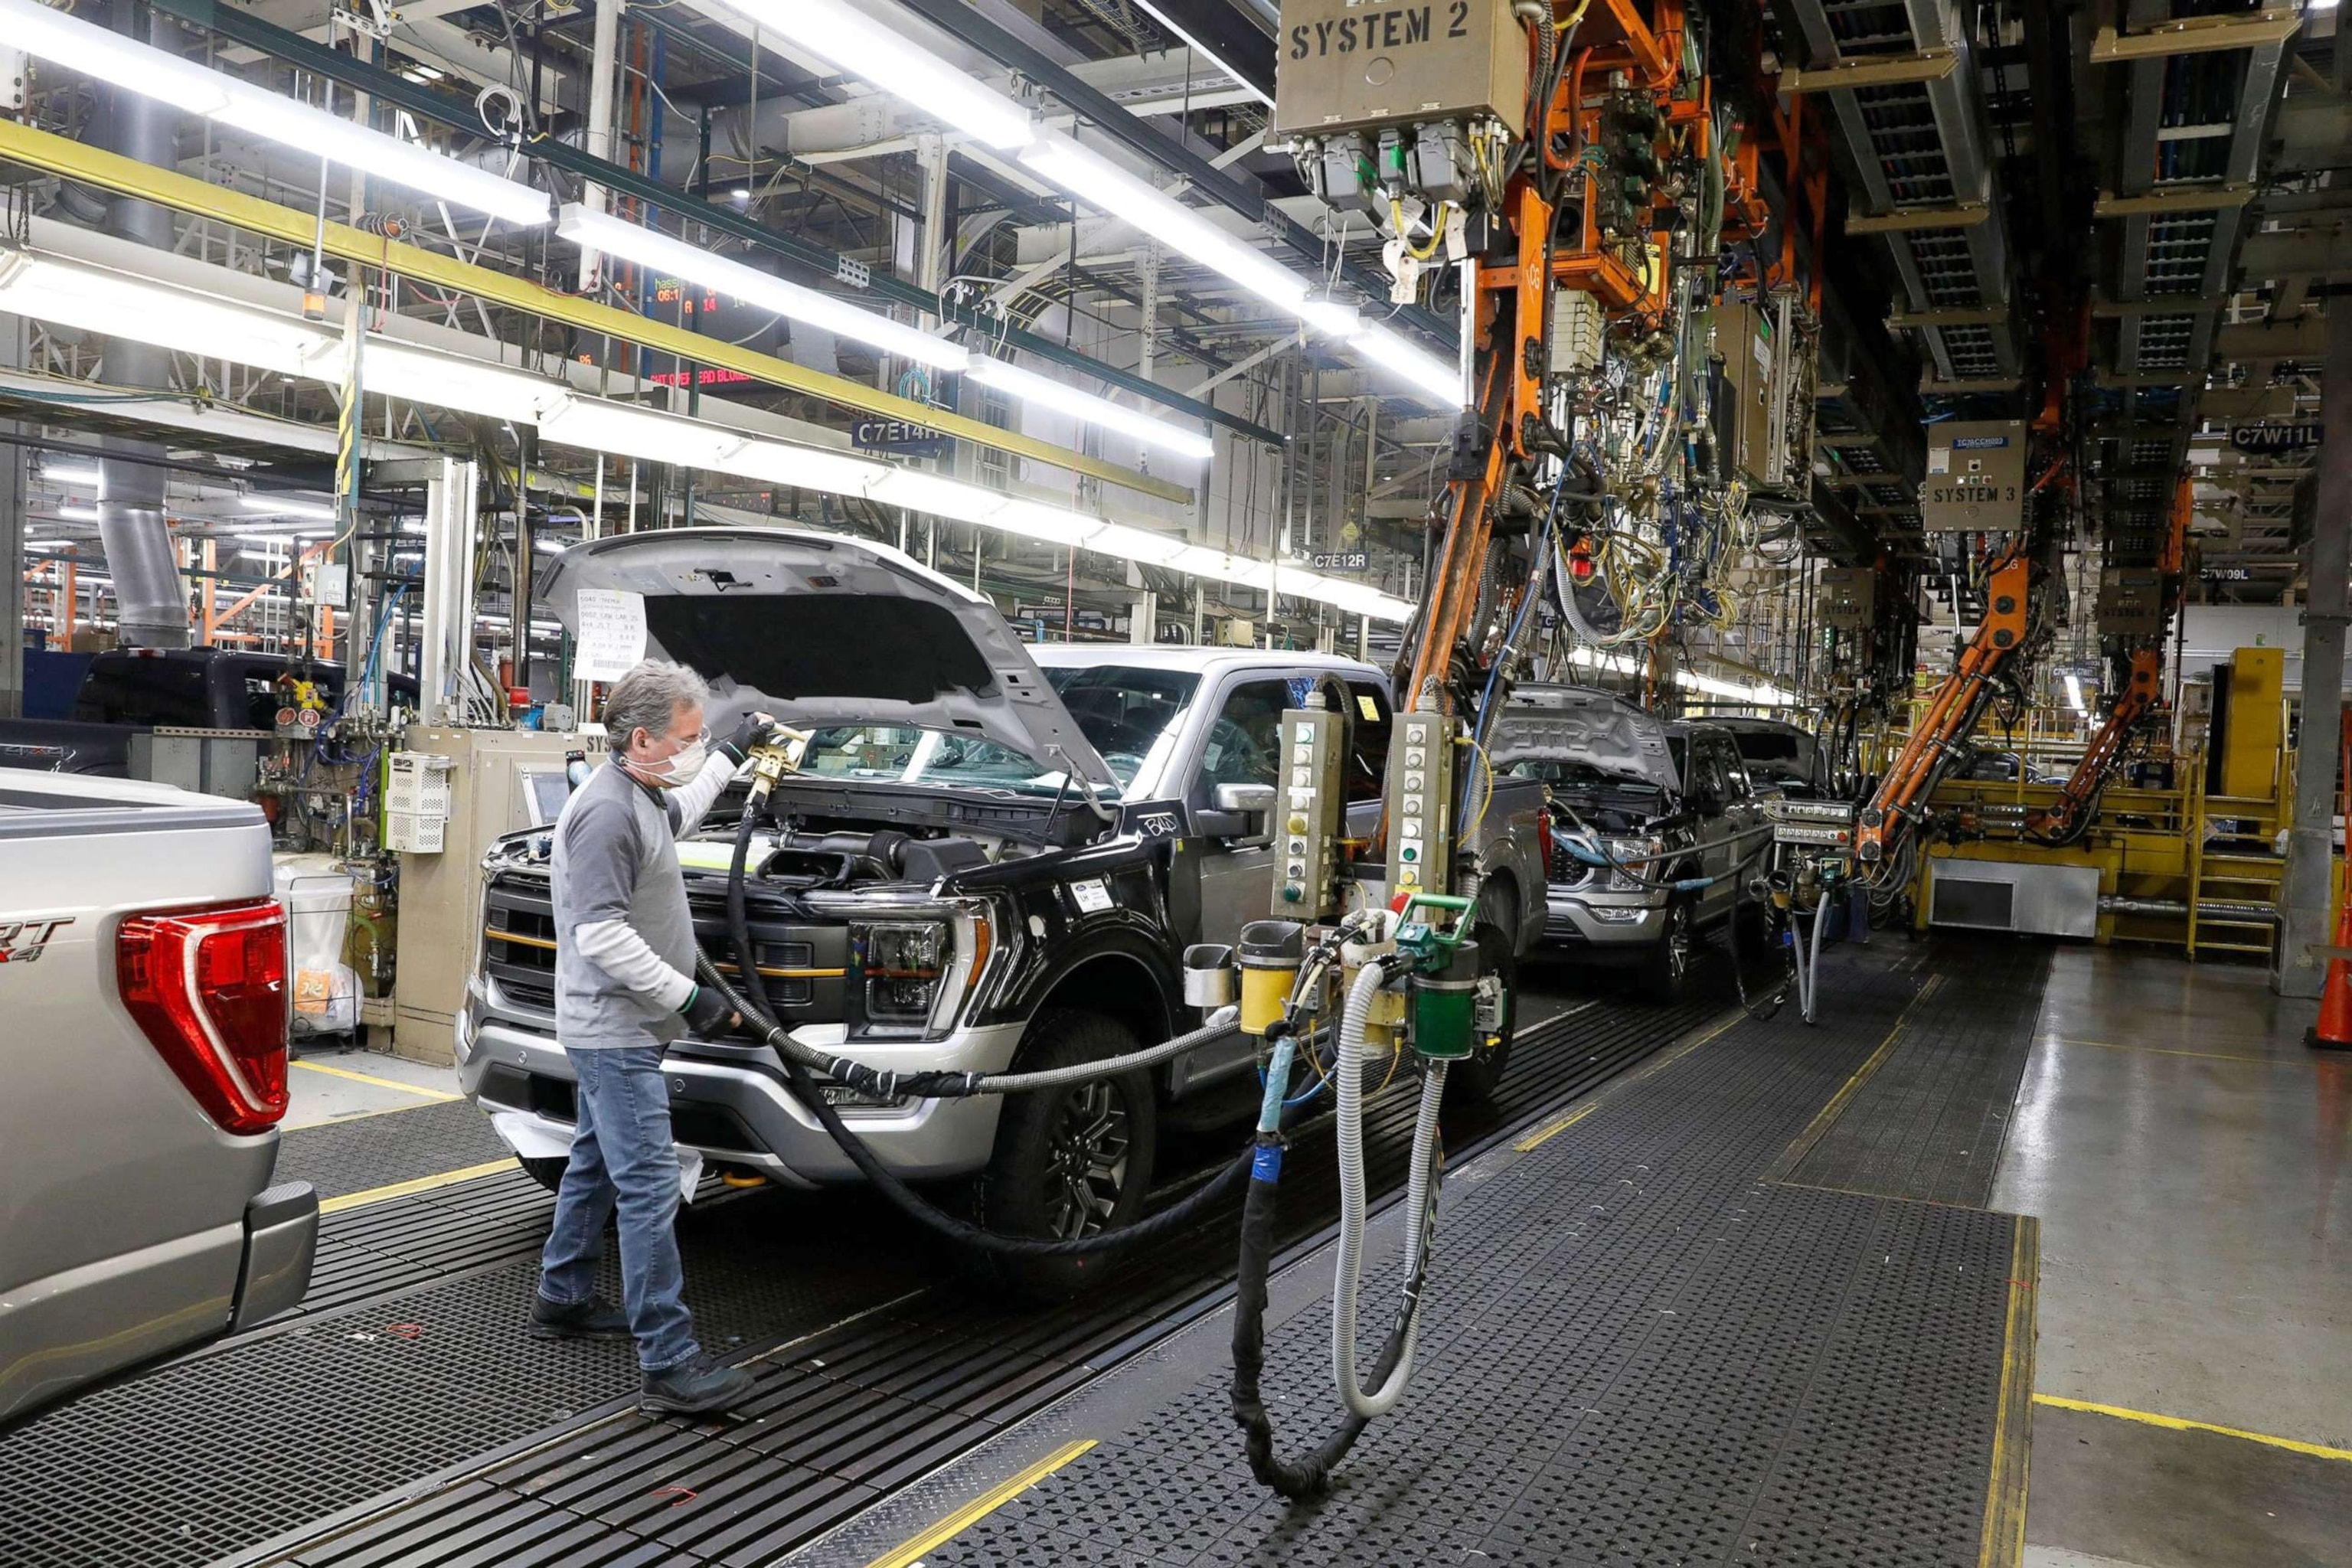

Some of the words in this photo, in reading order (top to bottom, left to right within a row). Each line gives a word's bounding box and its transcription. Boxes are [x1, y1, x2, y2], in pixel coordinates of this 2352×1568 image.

[1291, 7, 1430, 60] SYSTEM
[1449, 2, 1468, 38] 2
[2236, 428, 2319, 445] C7W11L
[1934, 488, 1998, 502] SYSTEM
[2006, 487, 2015, 501] 3
[1315, 554, 1365, 567] C7E12R
[2199, 568, 2249, 580] C7W09L
